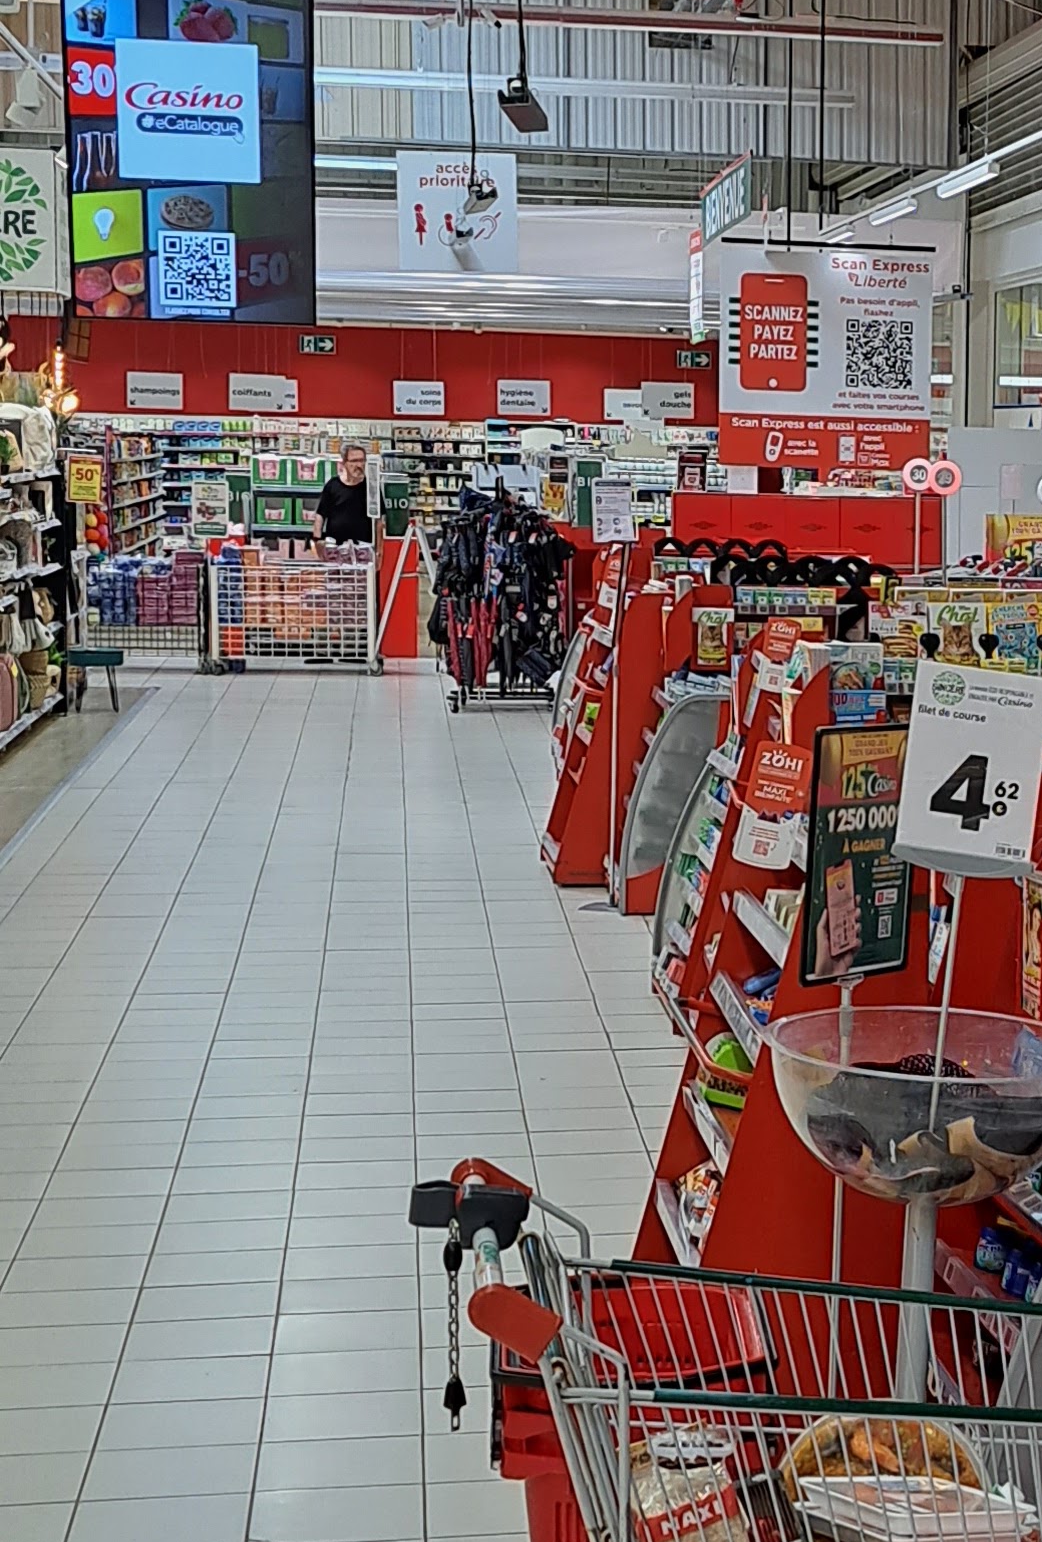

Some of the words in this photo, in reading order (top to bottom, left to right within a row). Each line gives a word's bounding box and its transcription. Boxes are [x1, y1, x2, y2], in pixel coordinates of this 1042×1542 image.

[124, 81, 244, 111] Casino
[141, 114, 240, 136] #eCatalogue
[832, 257, 868, 270] Scan
[872, 258, 931, 274] Express
[853, 275, 908, 289] Liberté
[744, 305, 805, 323] SCANNEZ
[753, 324, 795, 342] PAYEZ
[750, 343, 798, 361] PARTEZ
[232, 388, 272, 399] coiffants
[732, 416, 759, 428] Scan
[761, 417, 805, 430] Express
[911, 468, 927, 481] 30
[384, 498, 409, 510] BIO
[938, 605, 981, 625] Chat
[918, 704, 937, 716] filet
[938, 706, 951, 718] de
[952, 709, 987, 723] course
[929, 753, 991, 832] 4
[994, 780, 1020, 801] 62
[851, 837, 886, 853] GAGNER
